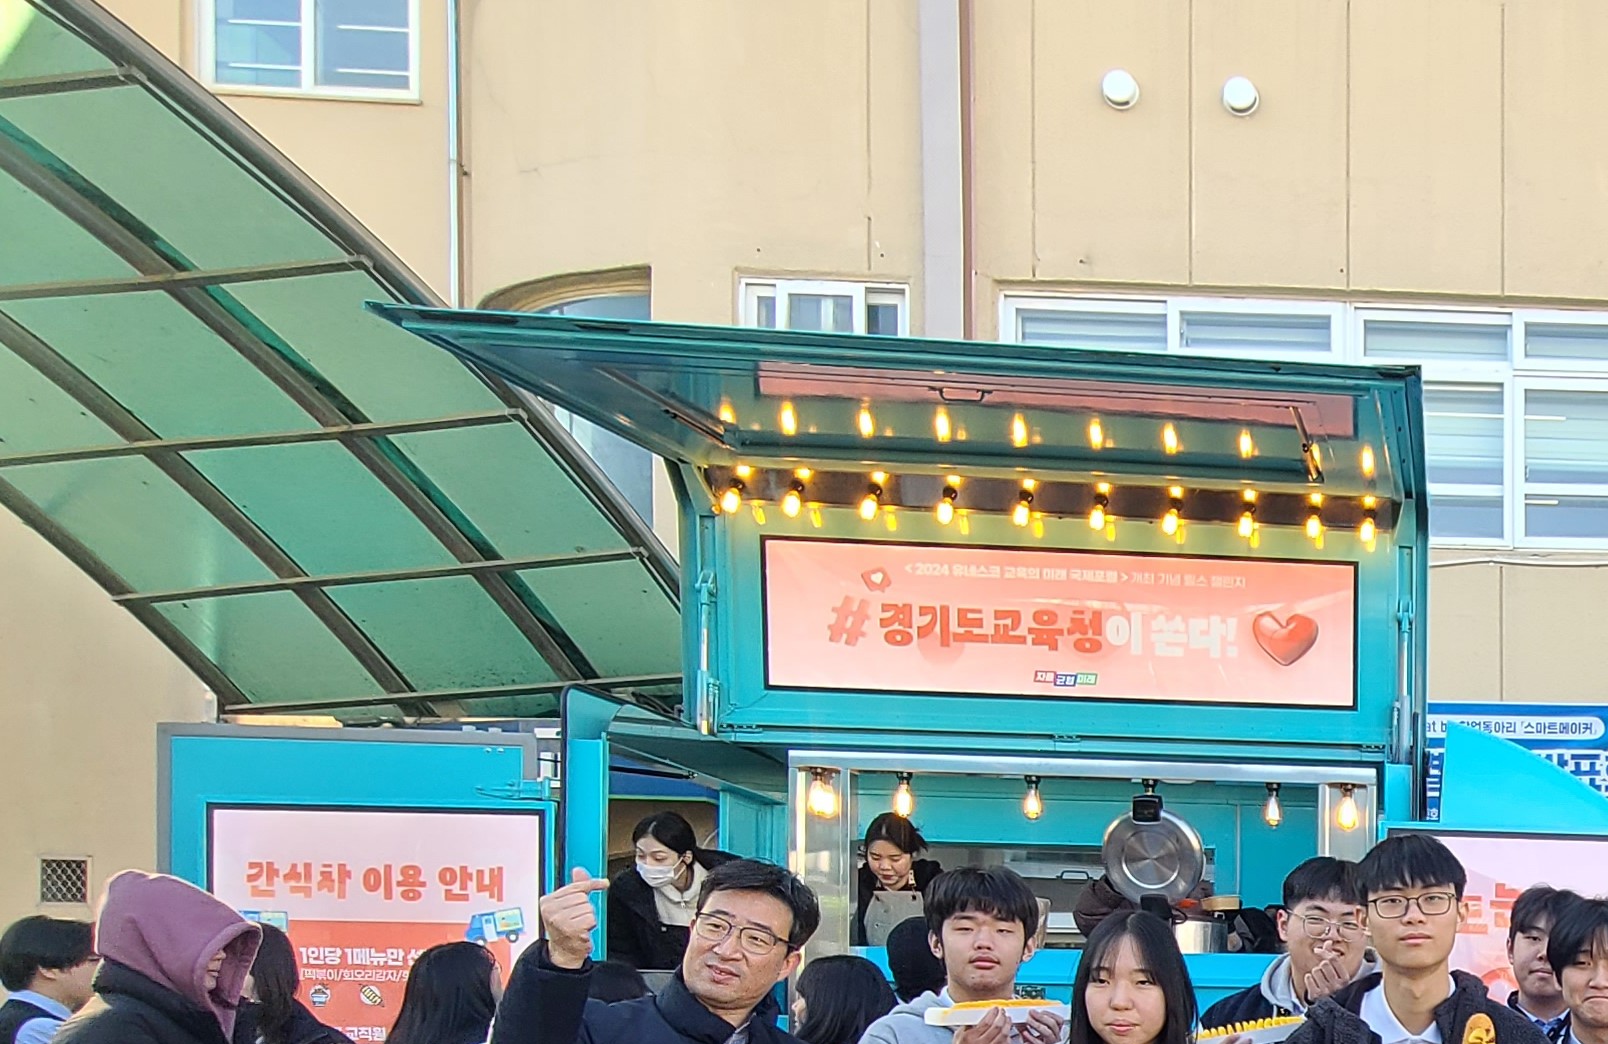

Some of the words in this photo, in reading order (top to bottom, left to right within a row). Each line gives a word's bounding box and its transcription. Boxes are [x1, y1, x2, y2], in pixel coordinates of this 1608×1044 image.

[915, 562, 949, 577] 2024
[952, 563, 1000, 578] 유네스코
[1003, 566, 1040, 580] 교육의
[1043, 568, 1067, 582] 미래
[1070, 569, 1118, 584] 국제포럼
[1131, 572, 1155, 585] 개최
[1150, 612, 1239, 660] 쓴다!
[246, 860, 352, 899] 간식차
[362, 863, 427, 902] 이용
[437, 865, 505, 902] 안내
[299, 946, 342, 965] 1인당
[344, 947, 405, 966] 1메뉴만
